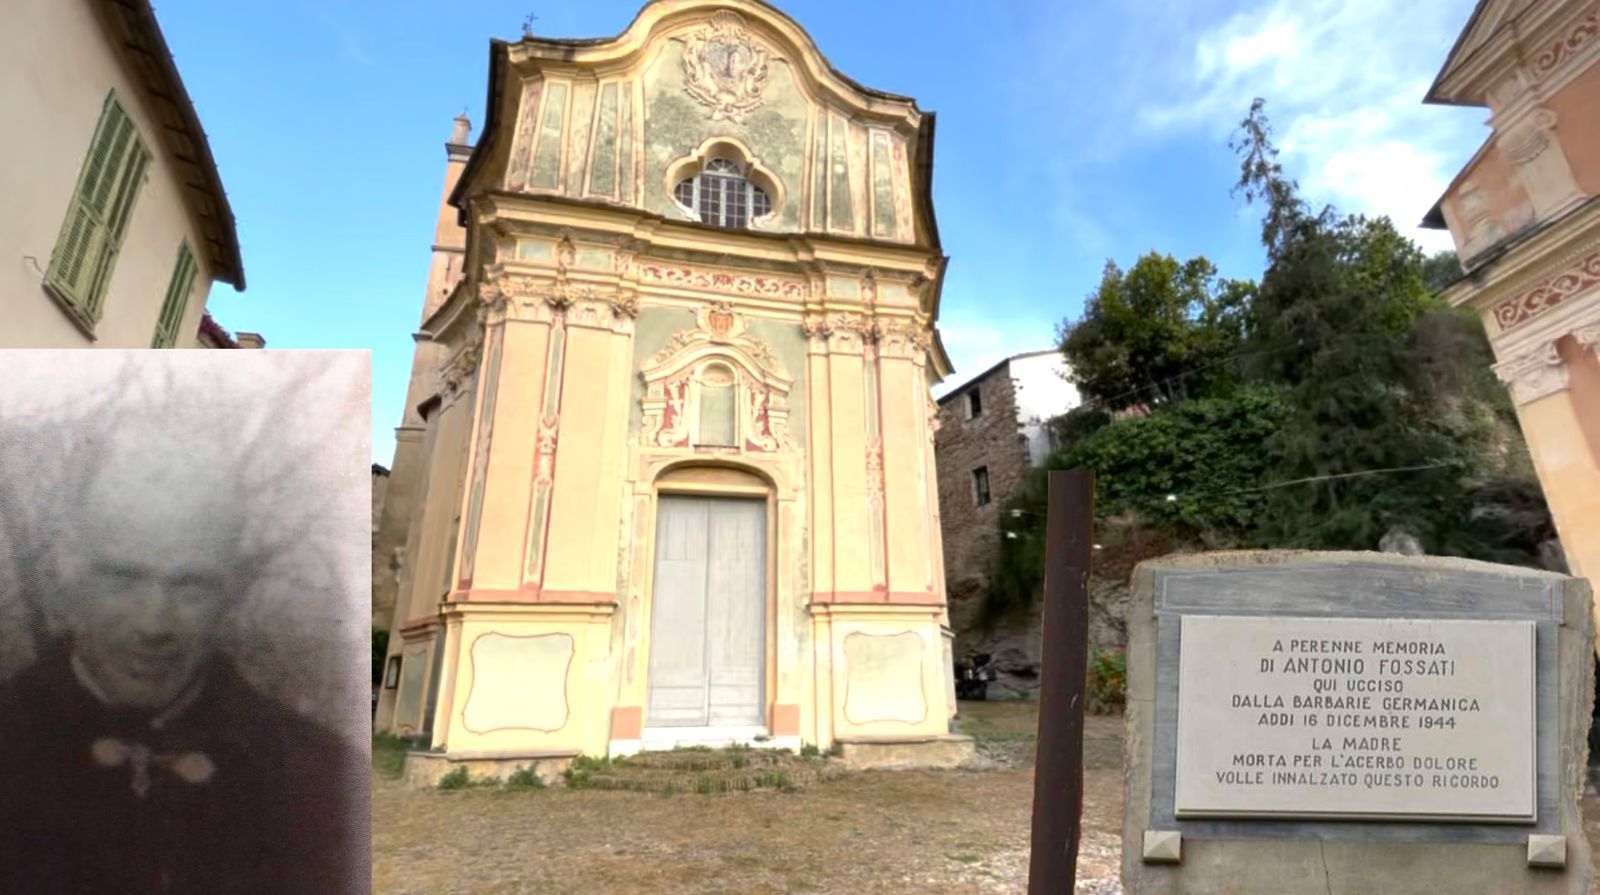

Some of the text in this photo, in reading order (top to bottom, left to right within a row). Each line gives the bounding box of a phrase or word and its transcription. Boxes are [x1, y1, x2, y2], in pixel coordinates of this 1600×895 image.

[1272, 640, 1446, 654] A PERENNE MEMORIA
[1259, 658, 1455, 675] DI ANTONIO FOSSATI
[1313, 679, 1404, 693] QUI UCCISO
[1231, 694, 1481, 712] DALLA BARBARIE GERMANICA
[1257, 713, 1457, 729] ADDI 16 DICEMBRE 1944
[1311, 737, 1402, 751] LA MADRE
[1232, 754, 1478, 770] MORTA PER L'ACERBO DOLORE
[1215, 771, 1500, 789] VOLLE INNALZATO QUESTO RICORDO
